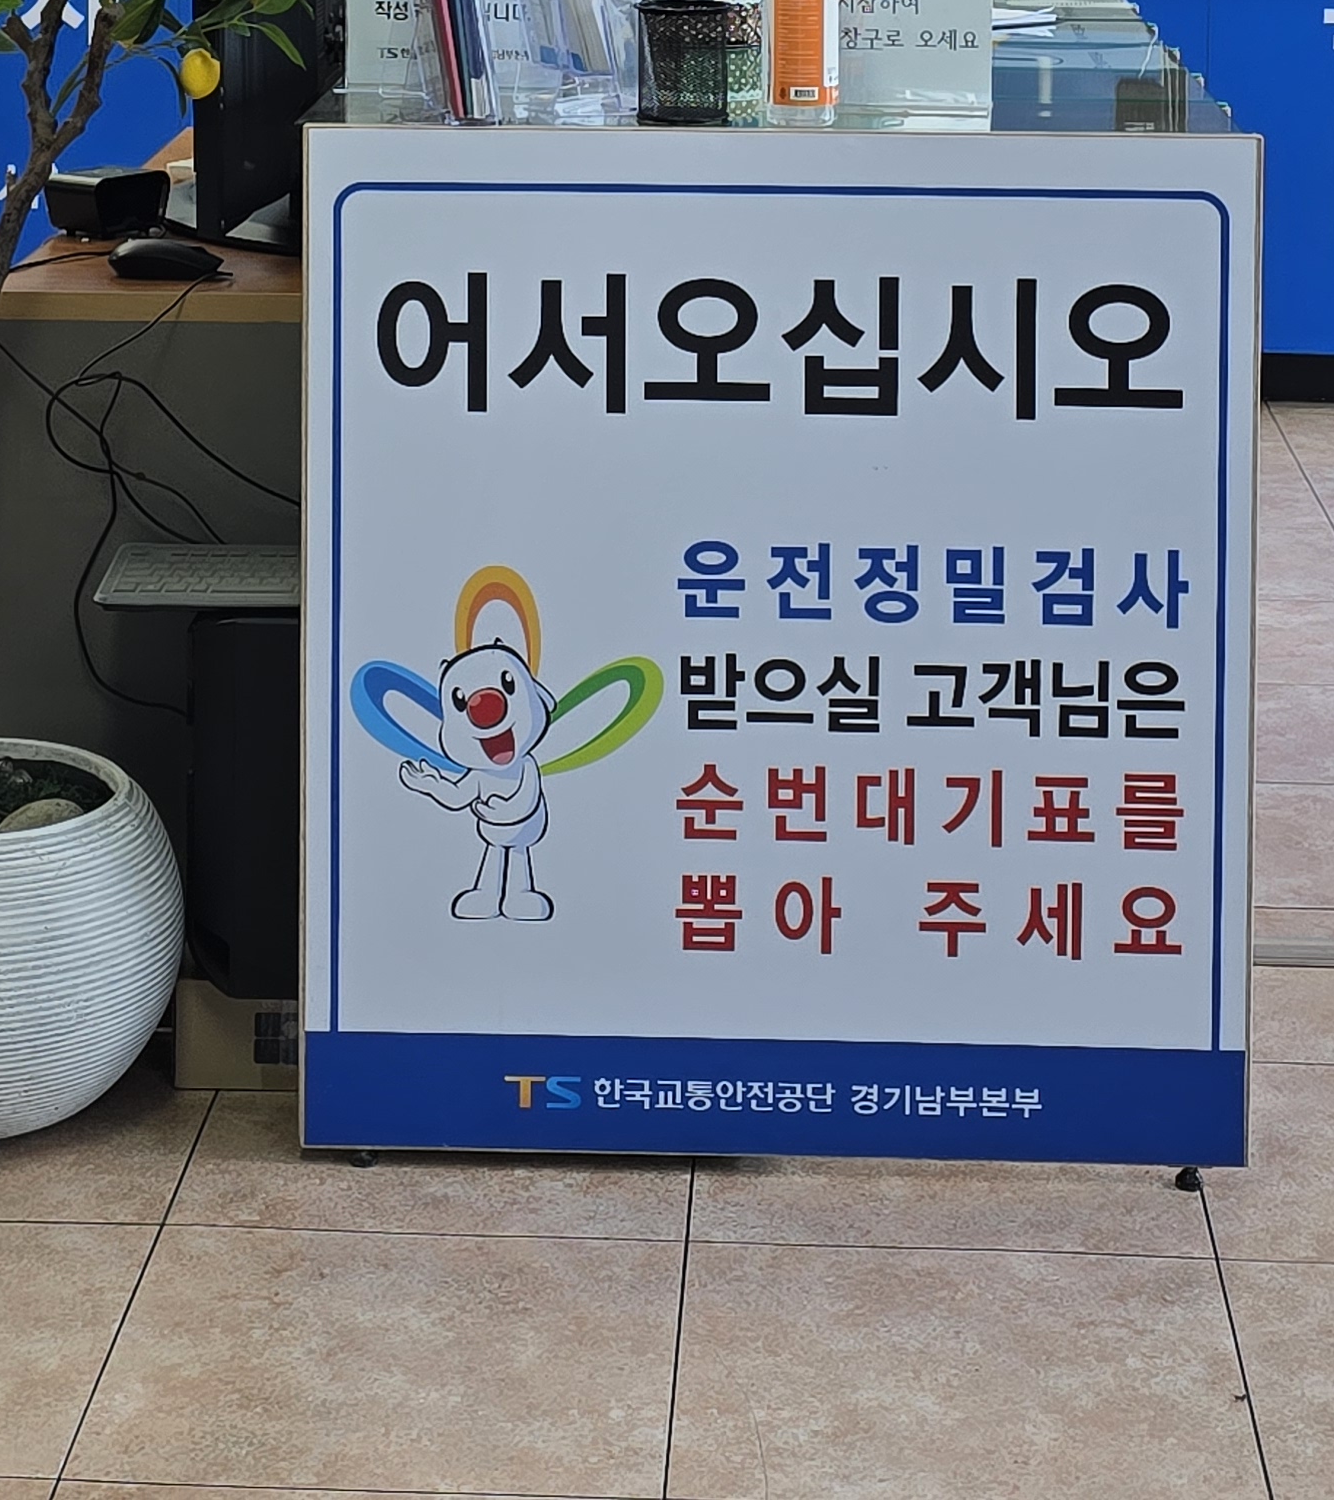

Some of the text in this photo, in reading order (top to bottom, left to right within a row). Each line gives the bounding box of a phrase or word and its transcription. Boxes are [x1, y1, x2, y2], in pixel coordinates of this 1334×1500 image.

[916, 28, 979, 51] 오세요
[376, 271, 1184, 421] 어서오십시오
[676, 540, 1190, 629] 운전정밀검사
[680, 655, 1186, 740] 받으실 고객님은
[675, 764, 1185, 852] 순번대기표를
[674, 874, 1184, 961] 뽑아 주세요
[504, 1074, 1043, 1120] TS 한국교통안전공단 경기남부본부
